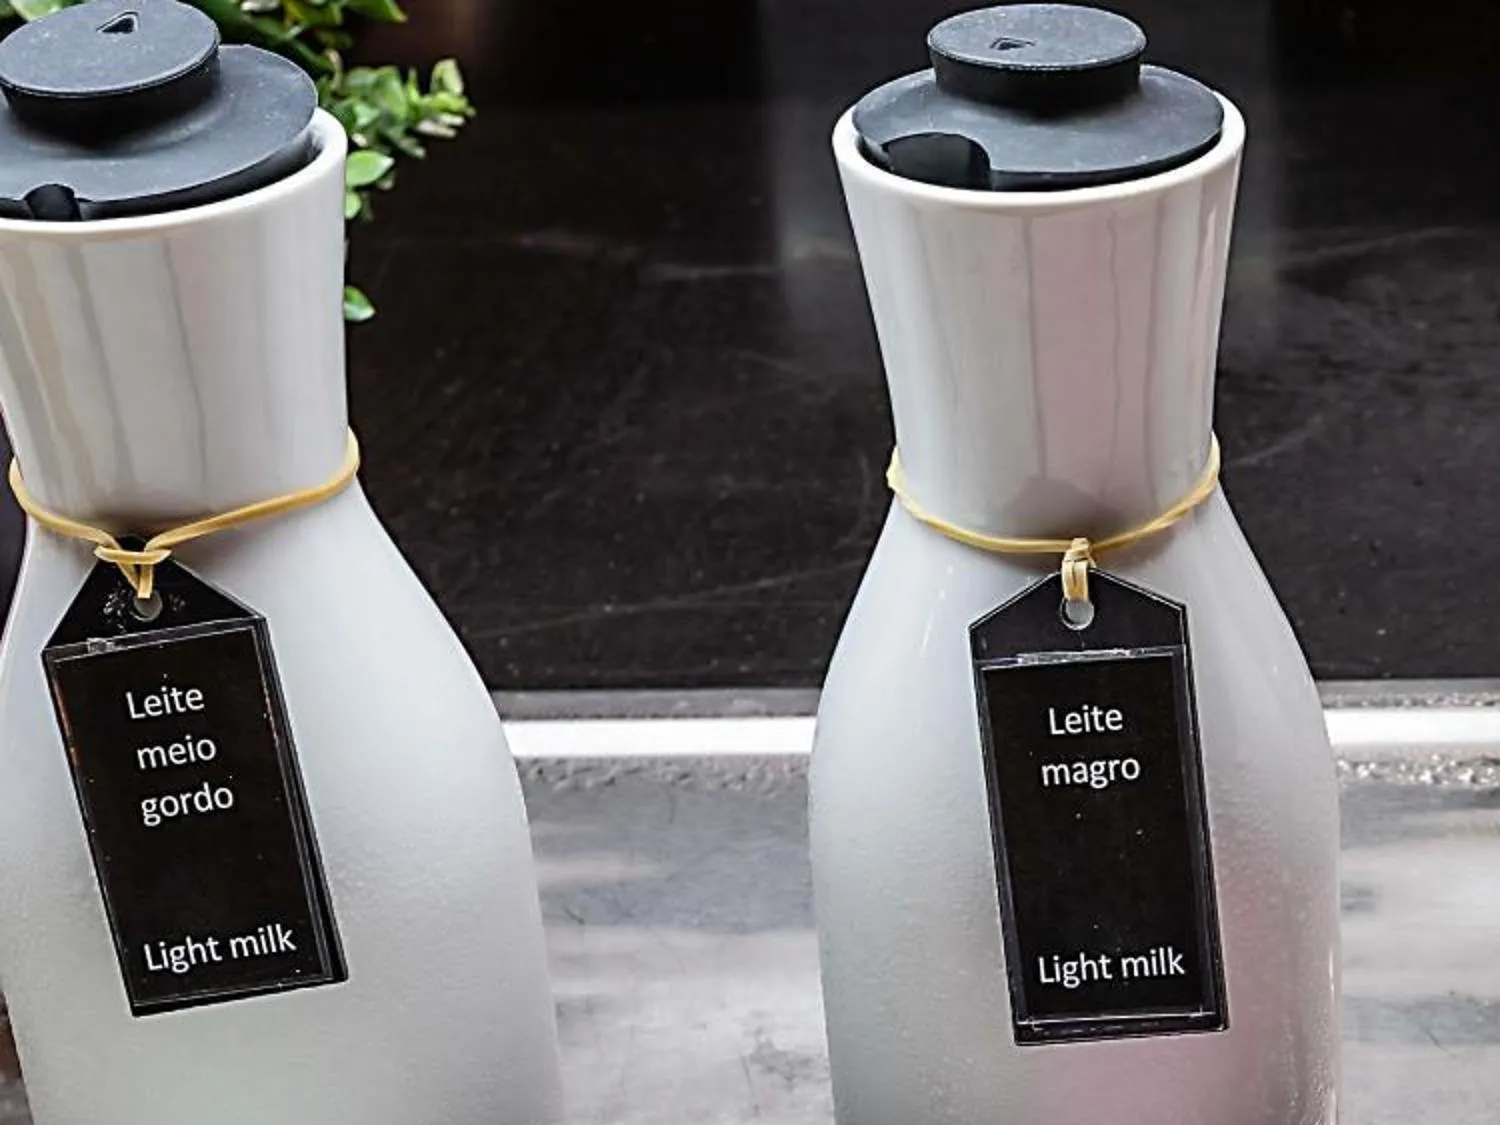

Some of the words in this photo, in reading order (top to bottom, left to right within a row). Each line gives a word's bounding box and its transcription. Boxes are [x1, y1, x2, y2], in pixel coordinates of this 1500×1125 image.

[126, 685, 206, 719] Leite
[1048, 704, 1124, 735] Leite
[137, 735, 217, 769] meio
[1040, 757, 1141, 790] magro
[141, 782, 234, 827] gordo
[144, 936, 223, 974] Light
[229, 923, 297, 959] milk
[1038, 952, 1113, 989] Light
[1119, 946, 1186, 978] milk
